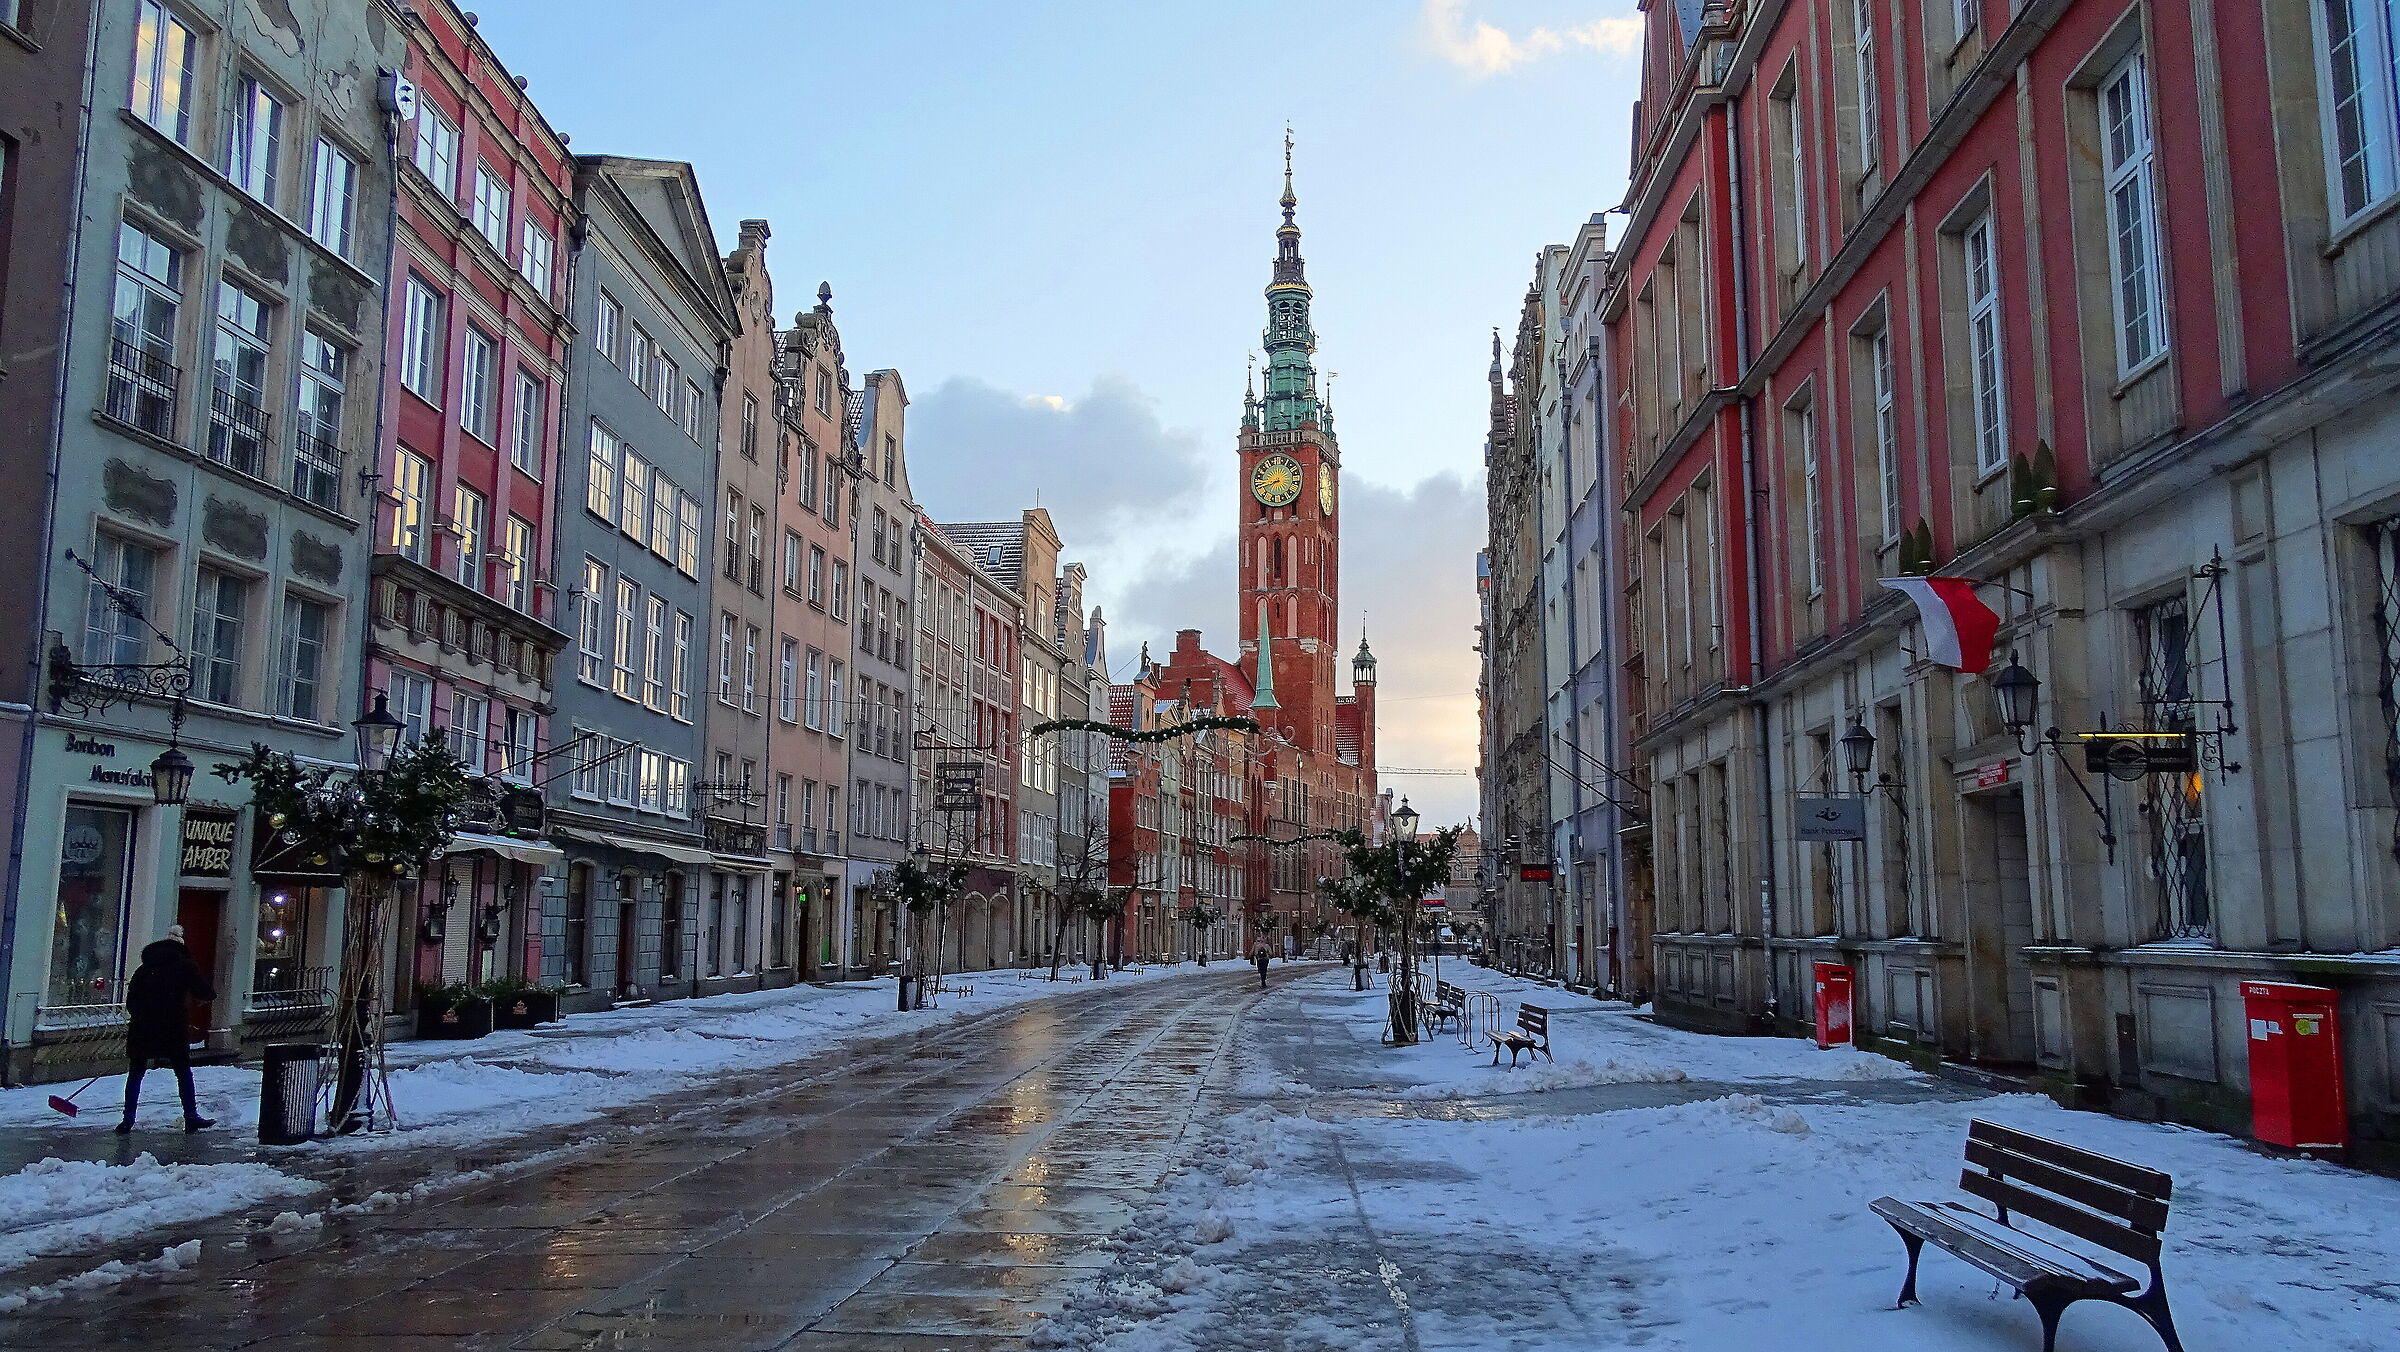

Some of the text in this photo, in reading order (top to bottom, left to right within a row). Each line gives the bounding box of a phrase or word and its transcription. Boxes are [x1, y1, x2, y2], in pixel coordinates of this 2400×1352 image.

[64, 732, 116, 757] Bonbon
[88, 764, 153, 788] Manufakt
[186, 819, 235, 845] UNIQUE
[182, 845, 231, 870] AMBER
